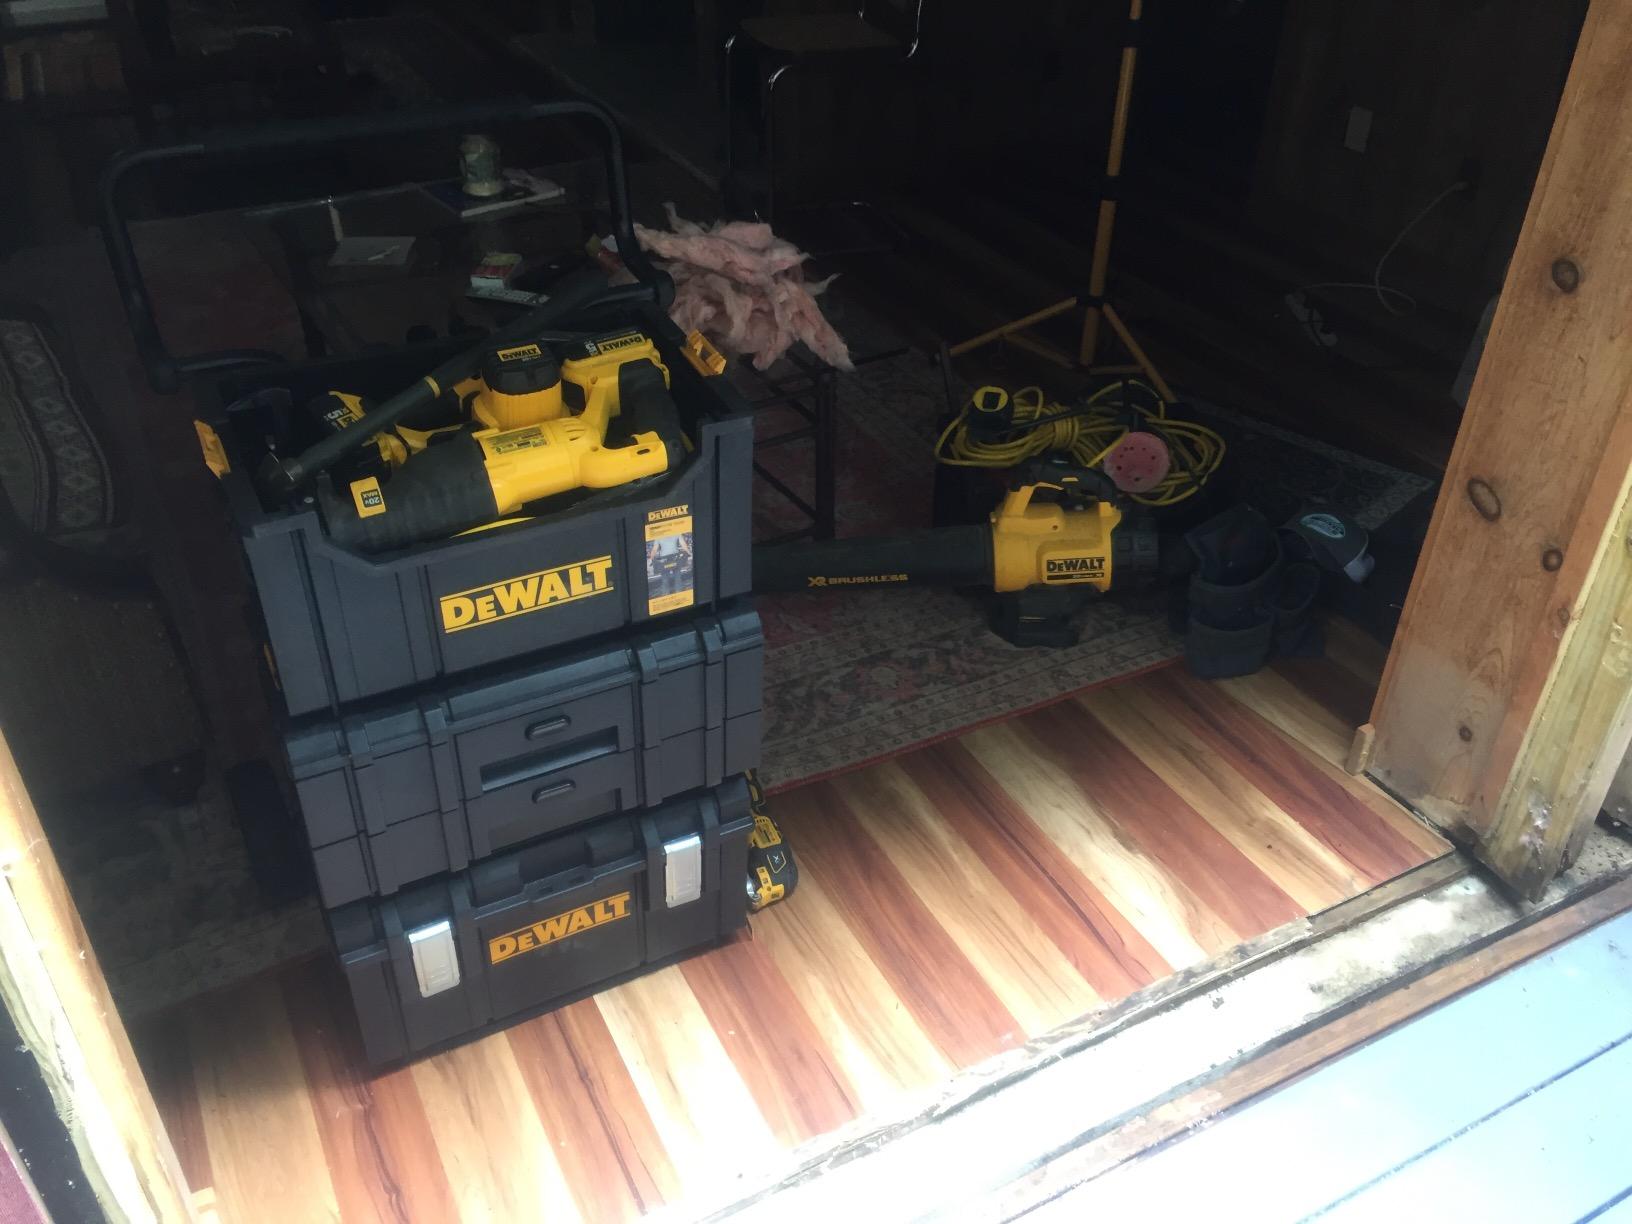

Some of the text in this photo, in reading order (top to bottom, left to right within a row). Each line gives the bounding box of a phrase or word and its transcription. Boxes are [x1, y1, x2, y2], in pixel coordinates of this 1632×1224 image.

[648, 504, 688, 522] DEWALT
[1046, 558, 1105, 573] DEWALT
[807, 573, 909, 588] XR BRUSHLESS
[440, 557, 613, 631] DEWALT
[489, 894, 630, 963] DEWALT
